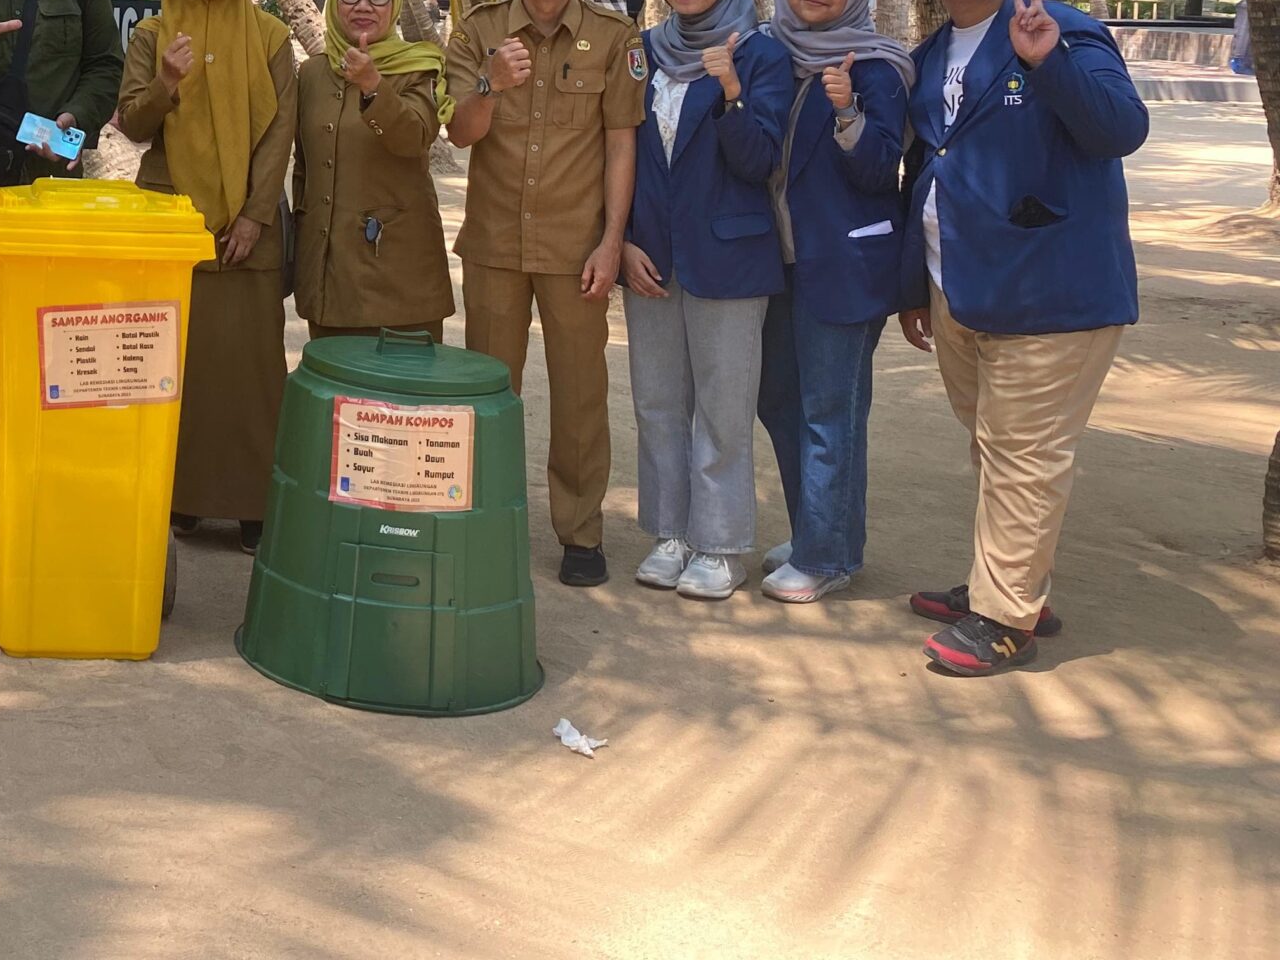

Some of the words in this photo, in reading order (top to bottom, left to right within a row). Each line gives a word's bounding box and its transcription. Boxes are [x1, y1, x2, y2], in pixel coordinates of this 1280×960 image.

[1004, 95, 1022, 105] ITS
[51, 316, 98, 327] SAMPAH
[100, 312, 168, 324] ANORGANIK
[357, 412, 404, 426] SAMPAH
[405, 417, 454, 428] KOMPOS
[354, 433, 369, 442] Sisa
[372, 435, 408, 446] Makanan
[426, 439, 460, 448] Tanaman
[354, 448, 373, 457] Buah
[425, 455, 445, 463] Daun
[353, 463, 375, 474] Sayur
[424, 470, 454, 480] Rumput
